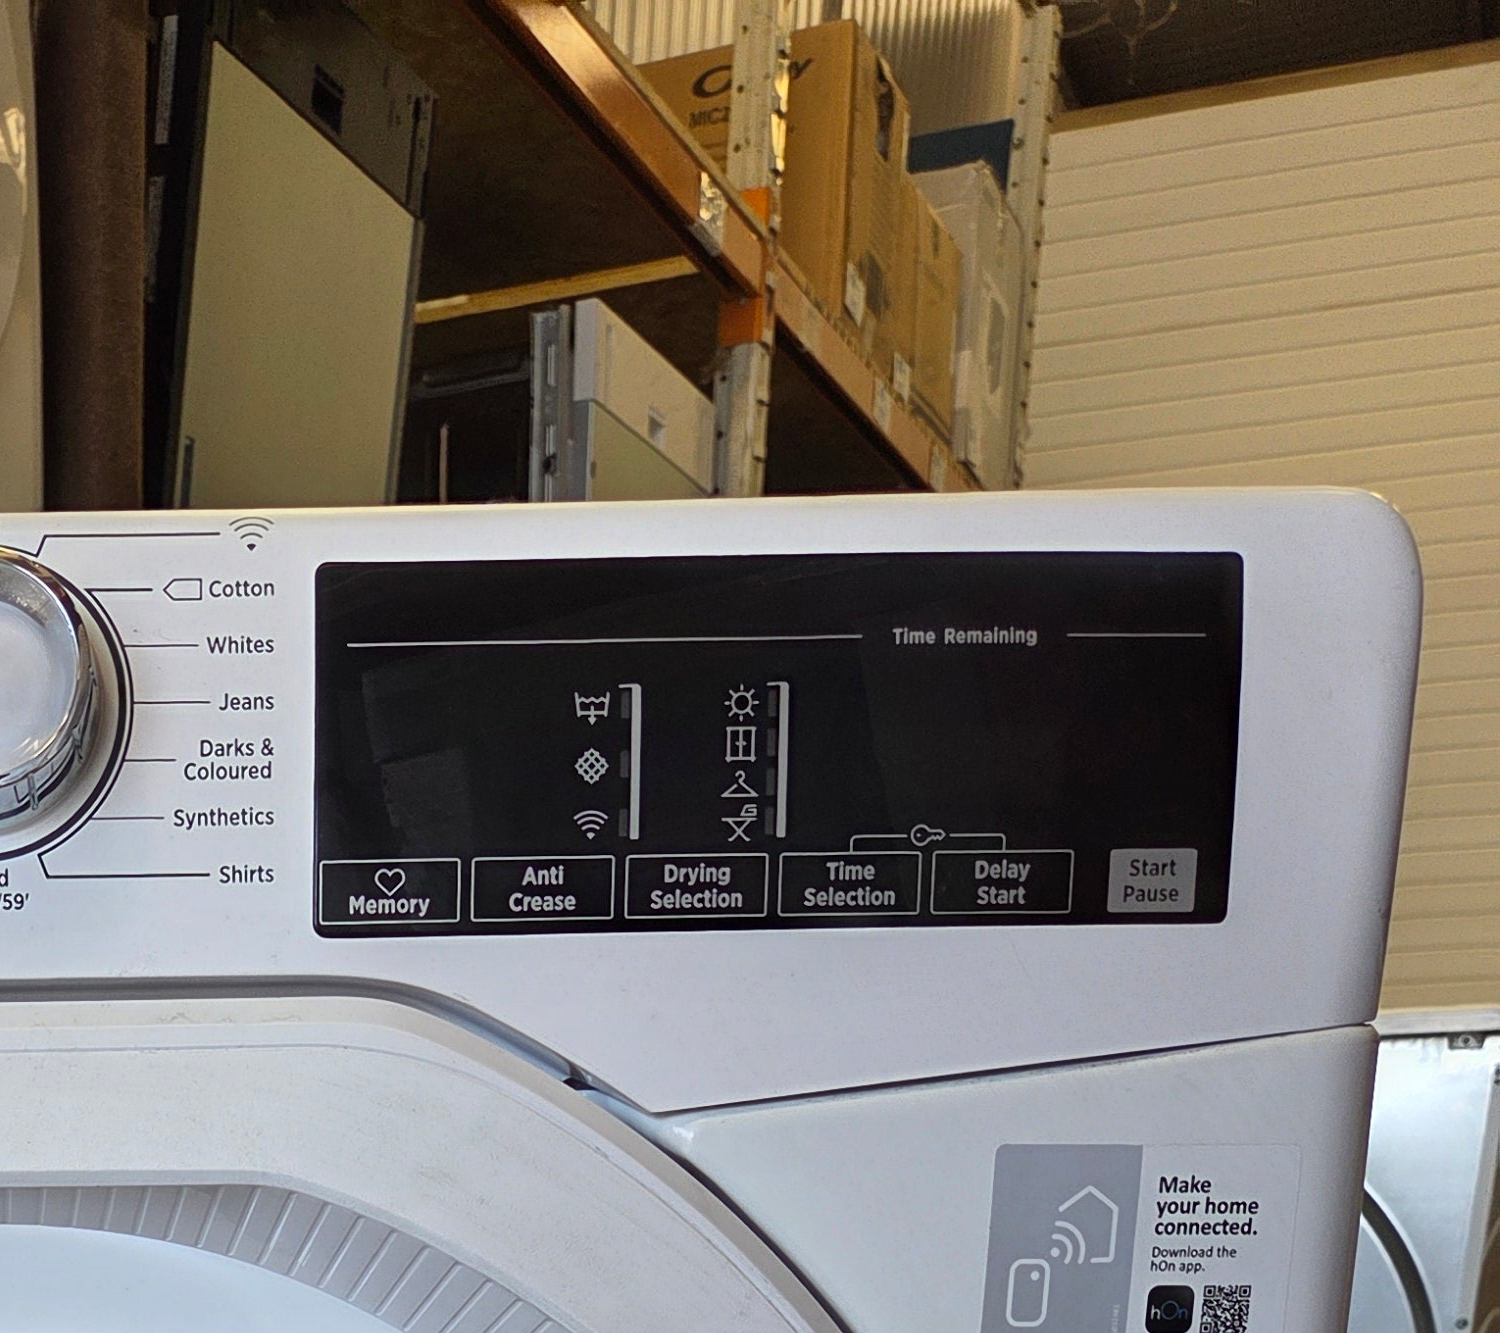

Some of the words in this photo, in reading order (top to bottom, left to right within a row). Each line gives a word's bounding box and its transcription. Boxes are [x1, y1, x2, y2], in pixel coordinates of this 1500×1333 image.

[208, 580, 275, 598] Cotton
[206, 635, 275, 655] Whites
[892, 626, 936, 645] Time
[944, 626, 1038, 647] Remaining
[218, 692, 275, 711] Jeans
[199, 737, 255, 758] Darks
[260, 737, 275, 757] &
[183, 760, 272, 781] Coloured
[173, 806, 275, 829] Synthetics
[219, 864, 275, 884] Shirts
[521, 864, 565, 886] Anti
[663, 862, 731, 886] Drying
[825, 860, 876, 881] Time
[974, 858, 1031, 882] Delay
[1129, 858, 1177, 877] Start
[508, 892, 577, 912] Crease
[650, 887, 743, 910] Selection
[803, 885, 896, 907] Selection
[976, 885, 1026, 905] Start
[1122, 884, 1179, 903] Pause
[348, 895, 431, 917] Memory
[1158, 1175, 1212, 1194] Make
[1156, 1200, 1201, 1219] your
[1204, 1196, 1260, 1215] home
[1154, 1217, 1258, 1236] connected.
[1151, 1245, 1213, 1259] Download
[1216, 1245, 1238, 1259] the
[1149, 1260, 1176, 1273] hOn
[1178, 1262, 1206, 1275] app.
[1150, 1300, 1188, 1321] hOn
